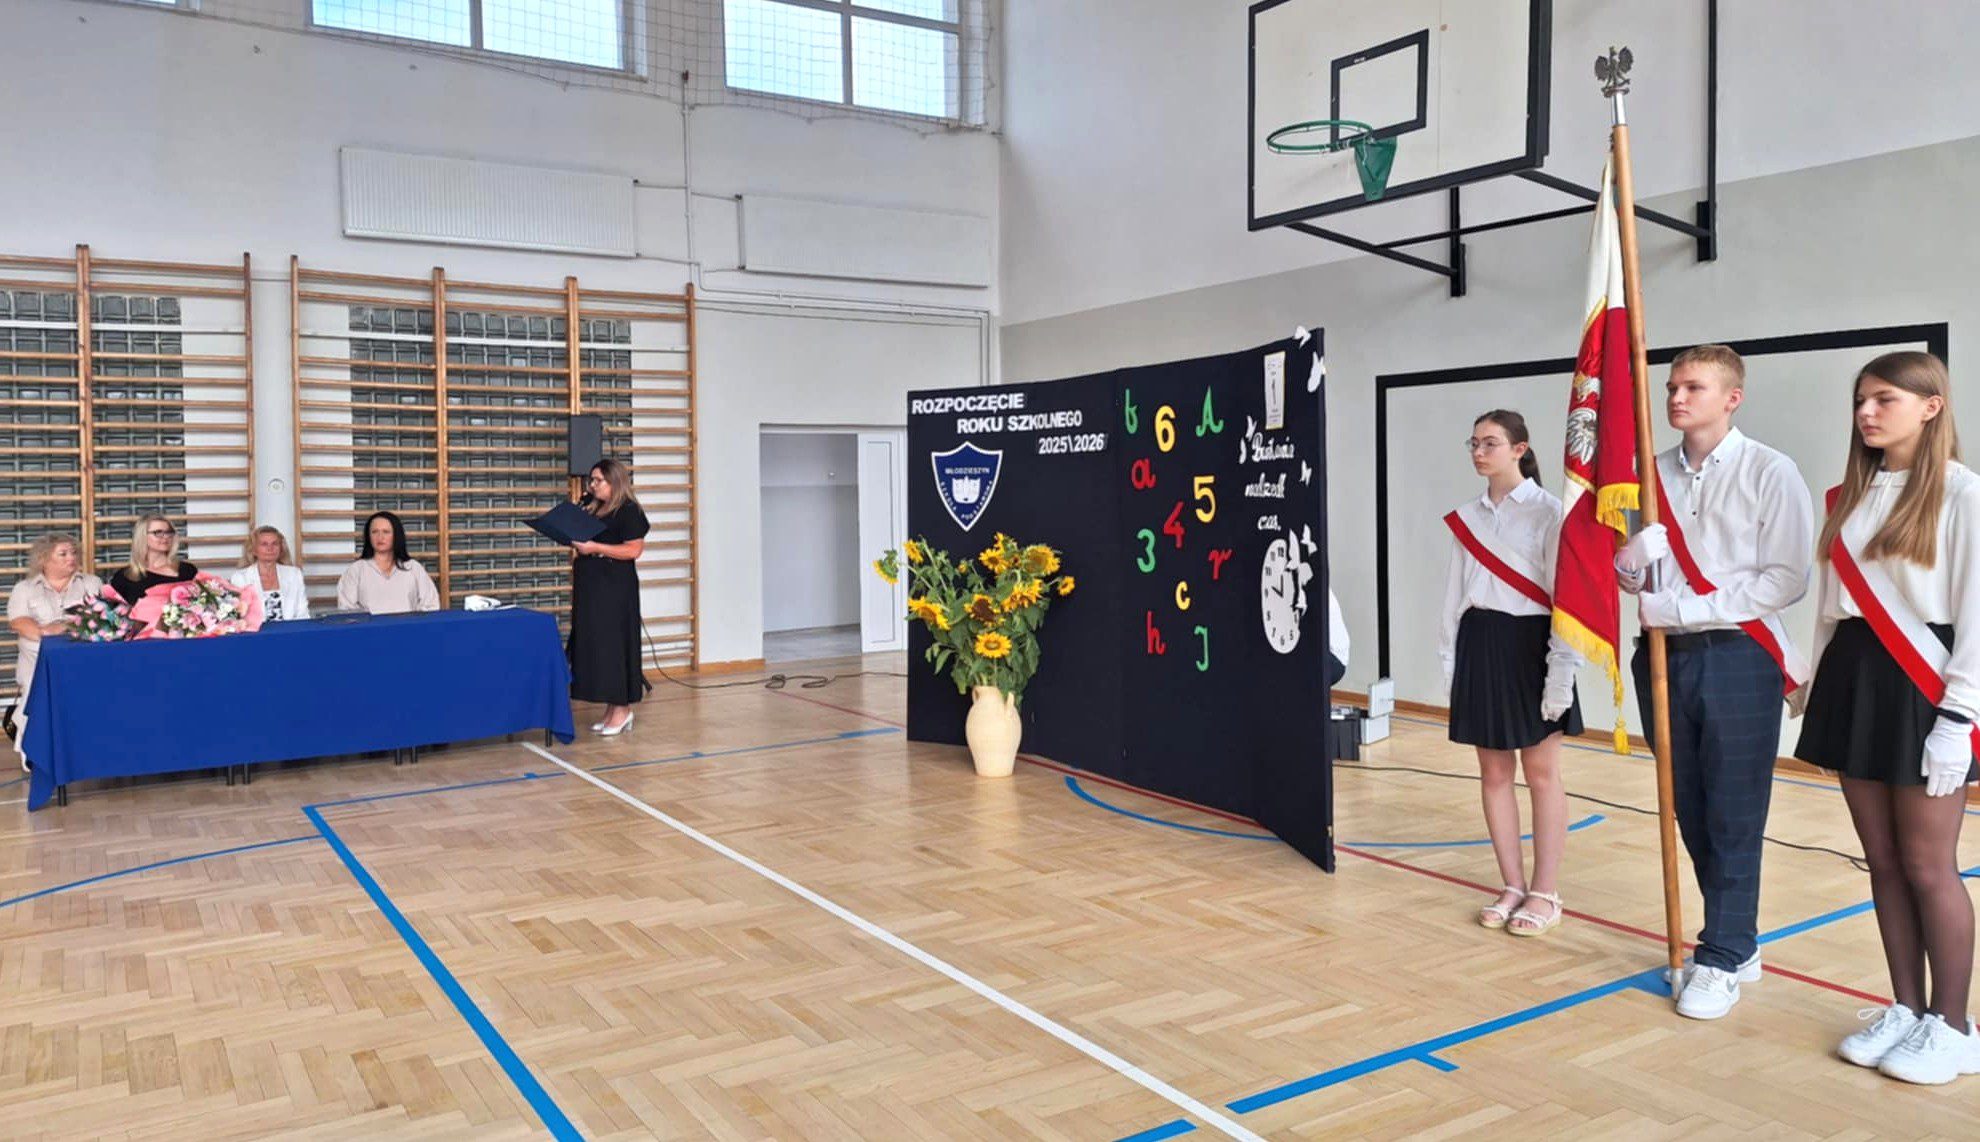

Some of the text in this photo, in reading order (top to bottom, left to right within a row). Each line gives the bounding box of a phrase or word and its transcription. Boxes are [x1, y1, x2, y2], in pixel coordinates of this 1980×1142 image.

[912, 393, 1024, 414] ROZPOCZĘCIE
[957, 410, 1082, 434] ROKU SZKOLNEGO
[1155, 405, 1176, 452] 6
[1132, 458, 1156, 489] a
[1194, 475, 1216, 523] 5
[1163, 501, 1185, 548] 4
[1137, 528, 1156, 572] 3
[1208, 549, 1232, 579] r
[1175, 581, 1191, 610] c
[1147, 610, 1166, 655] h
